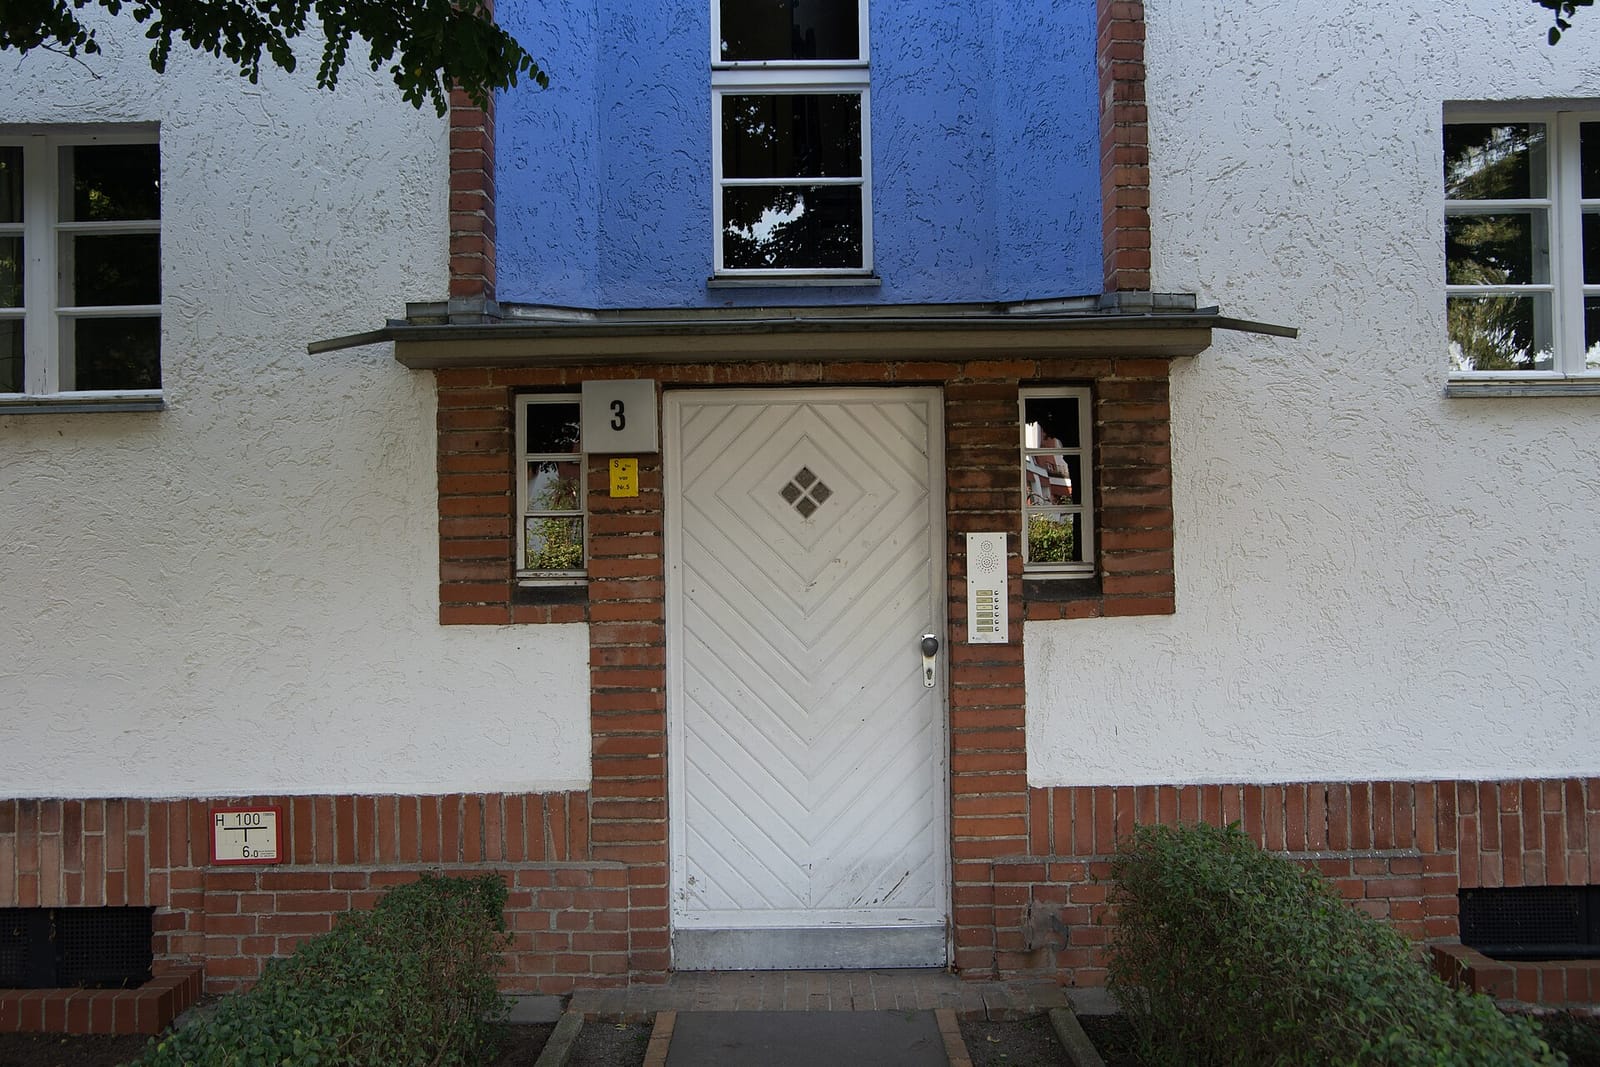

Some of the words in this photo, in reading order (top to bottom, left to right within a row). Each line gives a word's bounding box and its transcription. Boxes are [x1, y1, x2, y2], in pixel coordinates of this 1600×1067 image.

[610, 399, 625, 431] 3
[614, 459, 619, 468] S
[215, 814, 224, 826] H
[235, 813, 260, 826] 100
